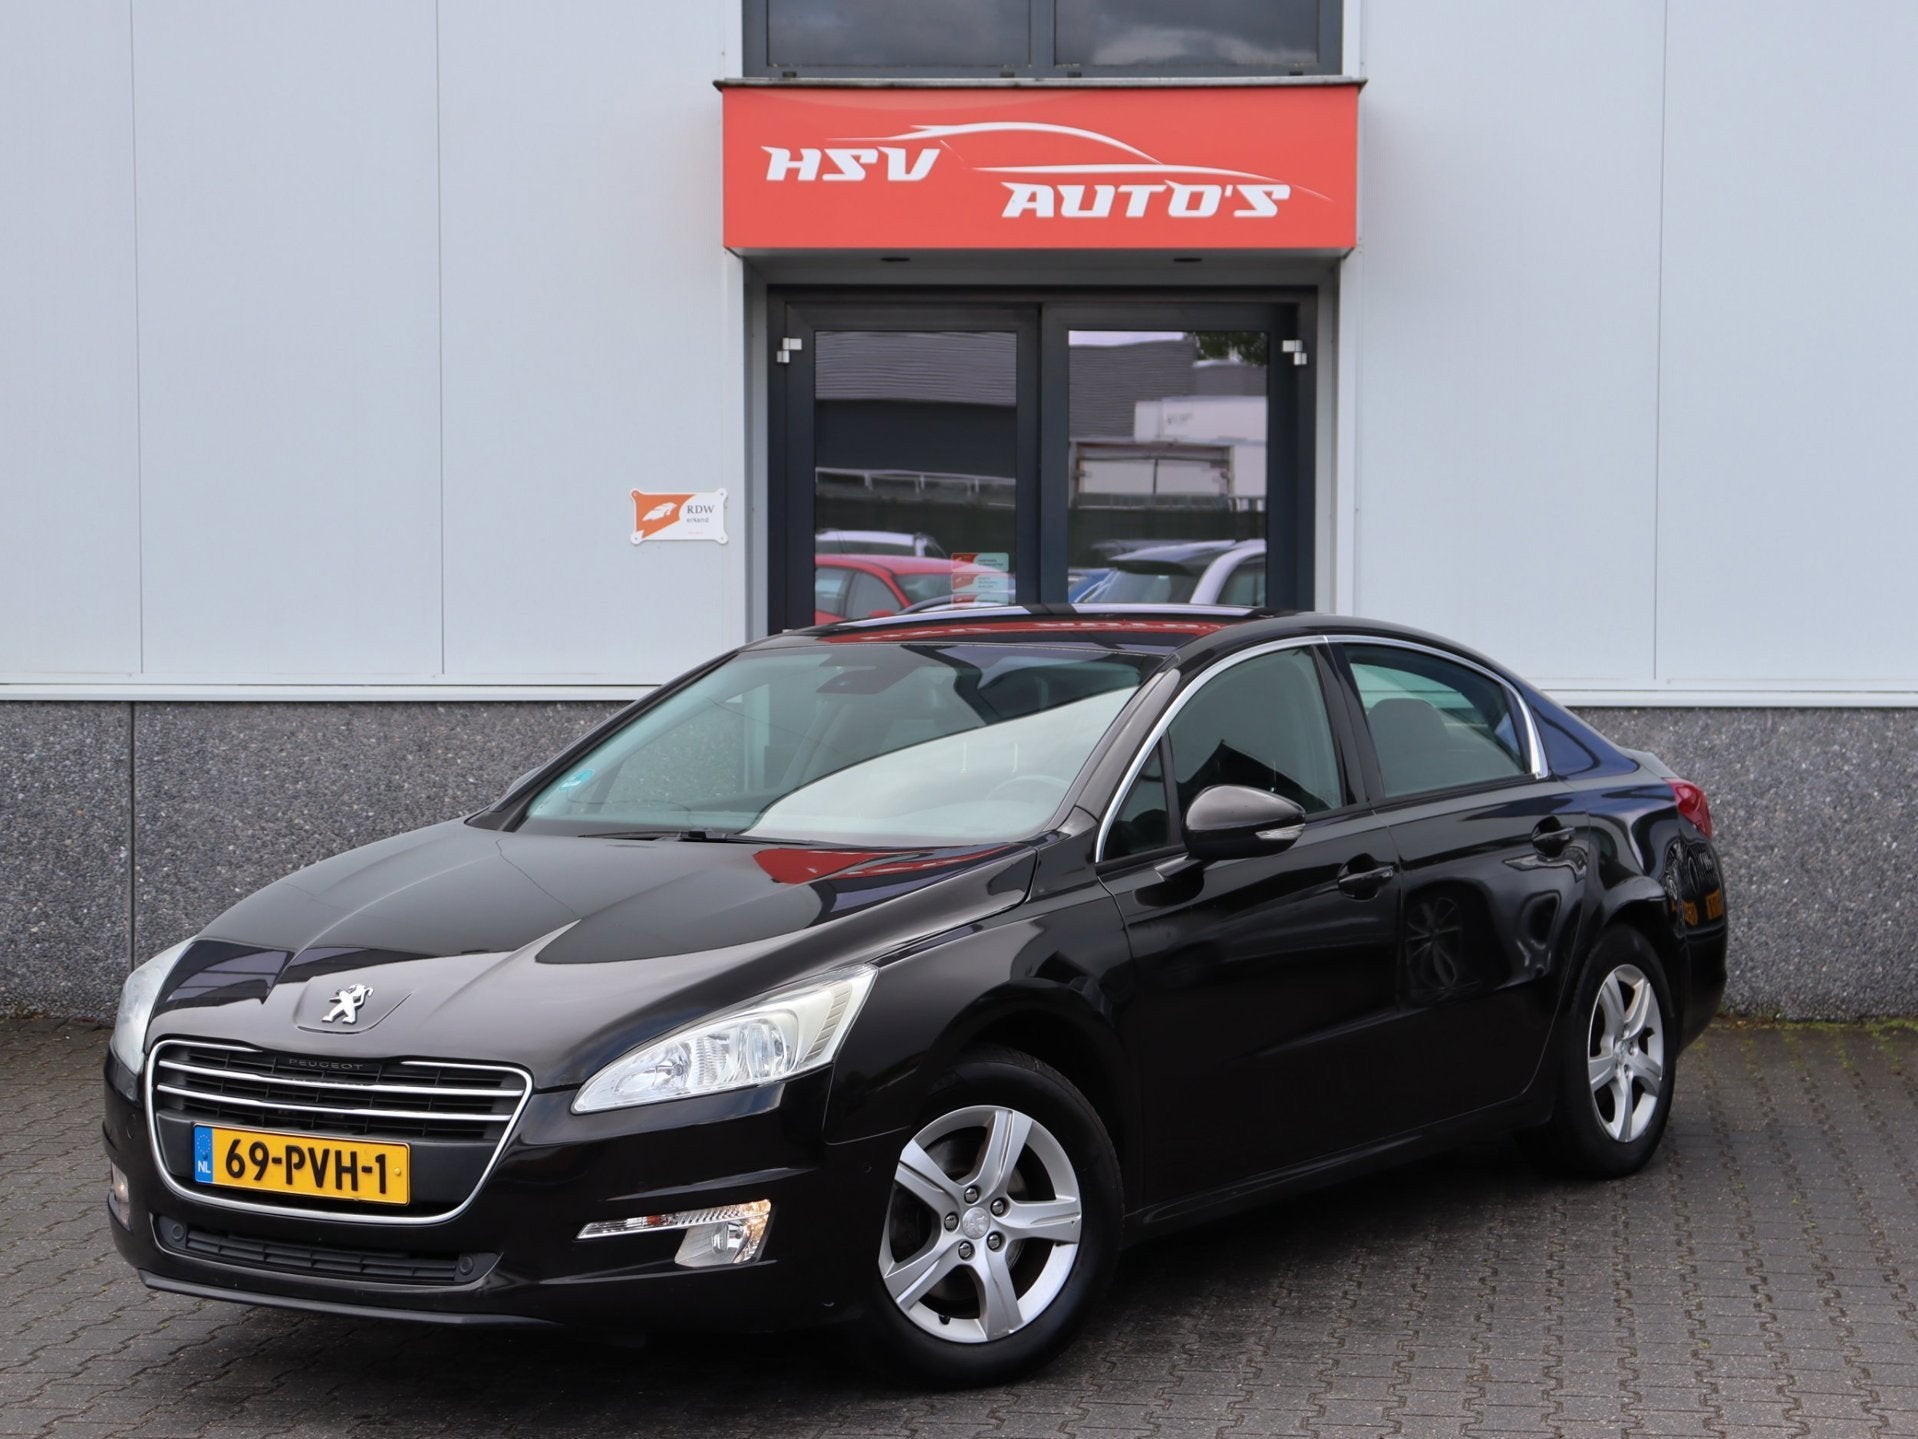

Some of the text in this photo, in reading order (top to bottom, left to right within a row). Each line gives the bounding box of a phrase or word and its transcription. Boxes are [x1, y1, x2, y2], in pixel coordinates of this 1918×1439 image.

[761, 146, 940, 181] HSV
[1001, 180, 1291, 218] AUTO'S
[687, 505, 715, 514] RDW
[288, 1058, 364, 1071] PEUGEOT
[197, 1160, 211, 1174] NL
[225, 1138, 387, 1195] 69-PVH-1
